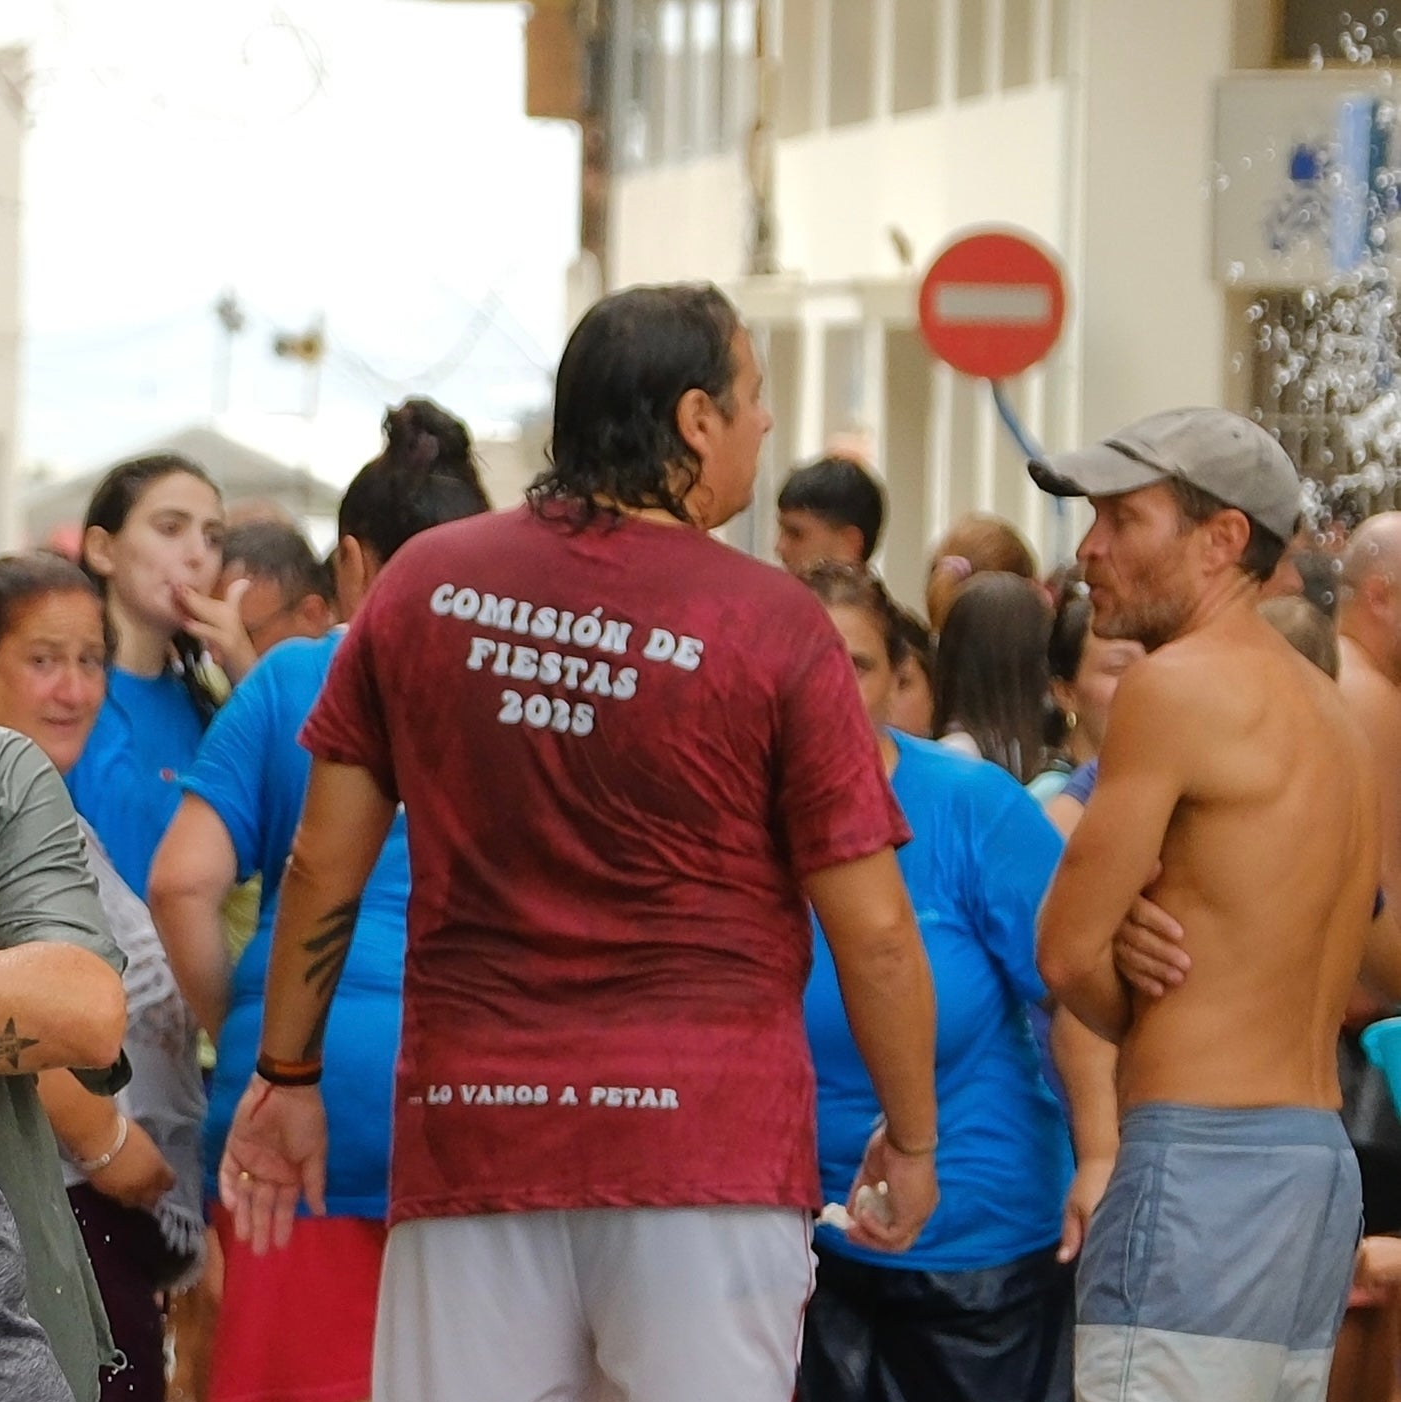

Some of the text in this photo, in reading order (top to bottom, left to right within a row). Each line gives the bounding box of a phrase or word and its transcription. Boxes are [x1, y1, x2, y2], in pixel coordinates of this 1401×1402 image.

[430, 583, 704, 671] COMISIÓN DE
[466, 636, 639, 700] FIESTAS
[497, 688, 595, 736] 2025
[460, 1084, 549, 1105] VAMOS
[558, 1085, 579, 1107] A
[590, 1086, 680, 1110] PETAR
